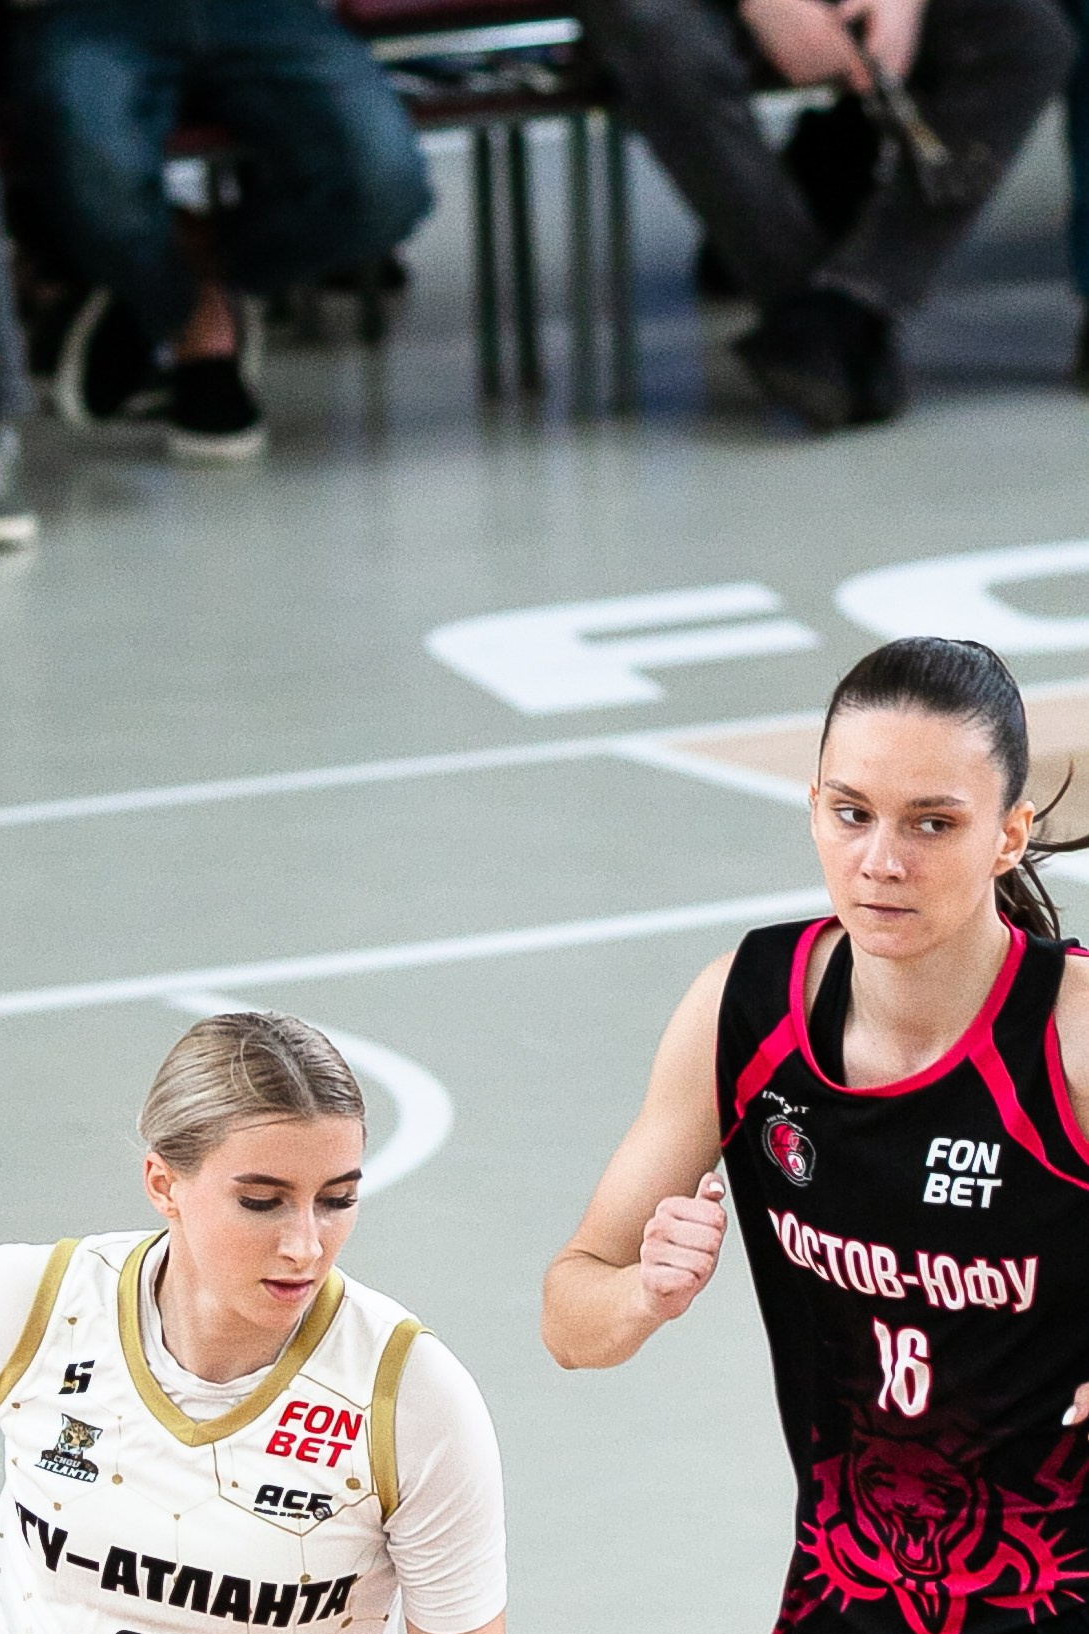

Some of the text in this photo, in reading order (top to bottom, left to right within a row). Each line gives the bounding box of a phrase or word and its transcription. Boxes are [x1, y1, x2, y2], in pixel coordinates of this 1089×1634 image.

[925, 1137, 1001, 1175] FON
[922, 1172, 1002, 1209] BET
[872, 1316, 931, 1418] 16
[278, 1400, 363, 1441] FON
[265, 1429, 353, 1468] BET
[35, 1458, 97, 1482] ATLANTA
[13, 1498, 358, 1628] ГУ-АТЛАНТА
